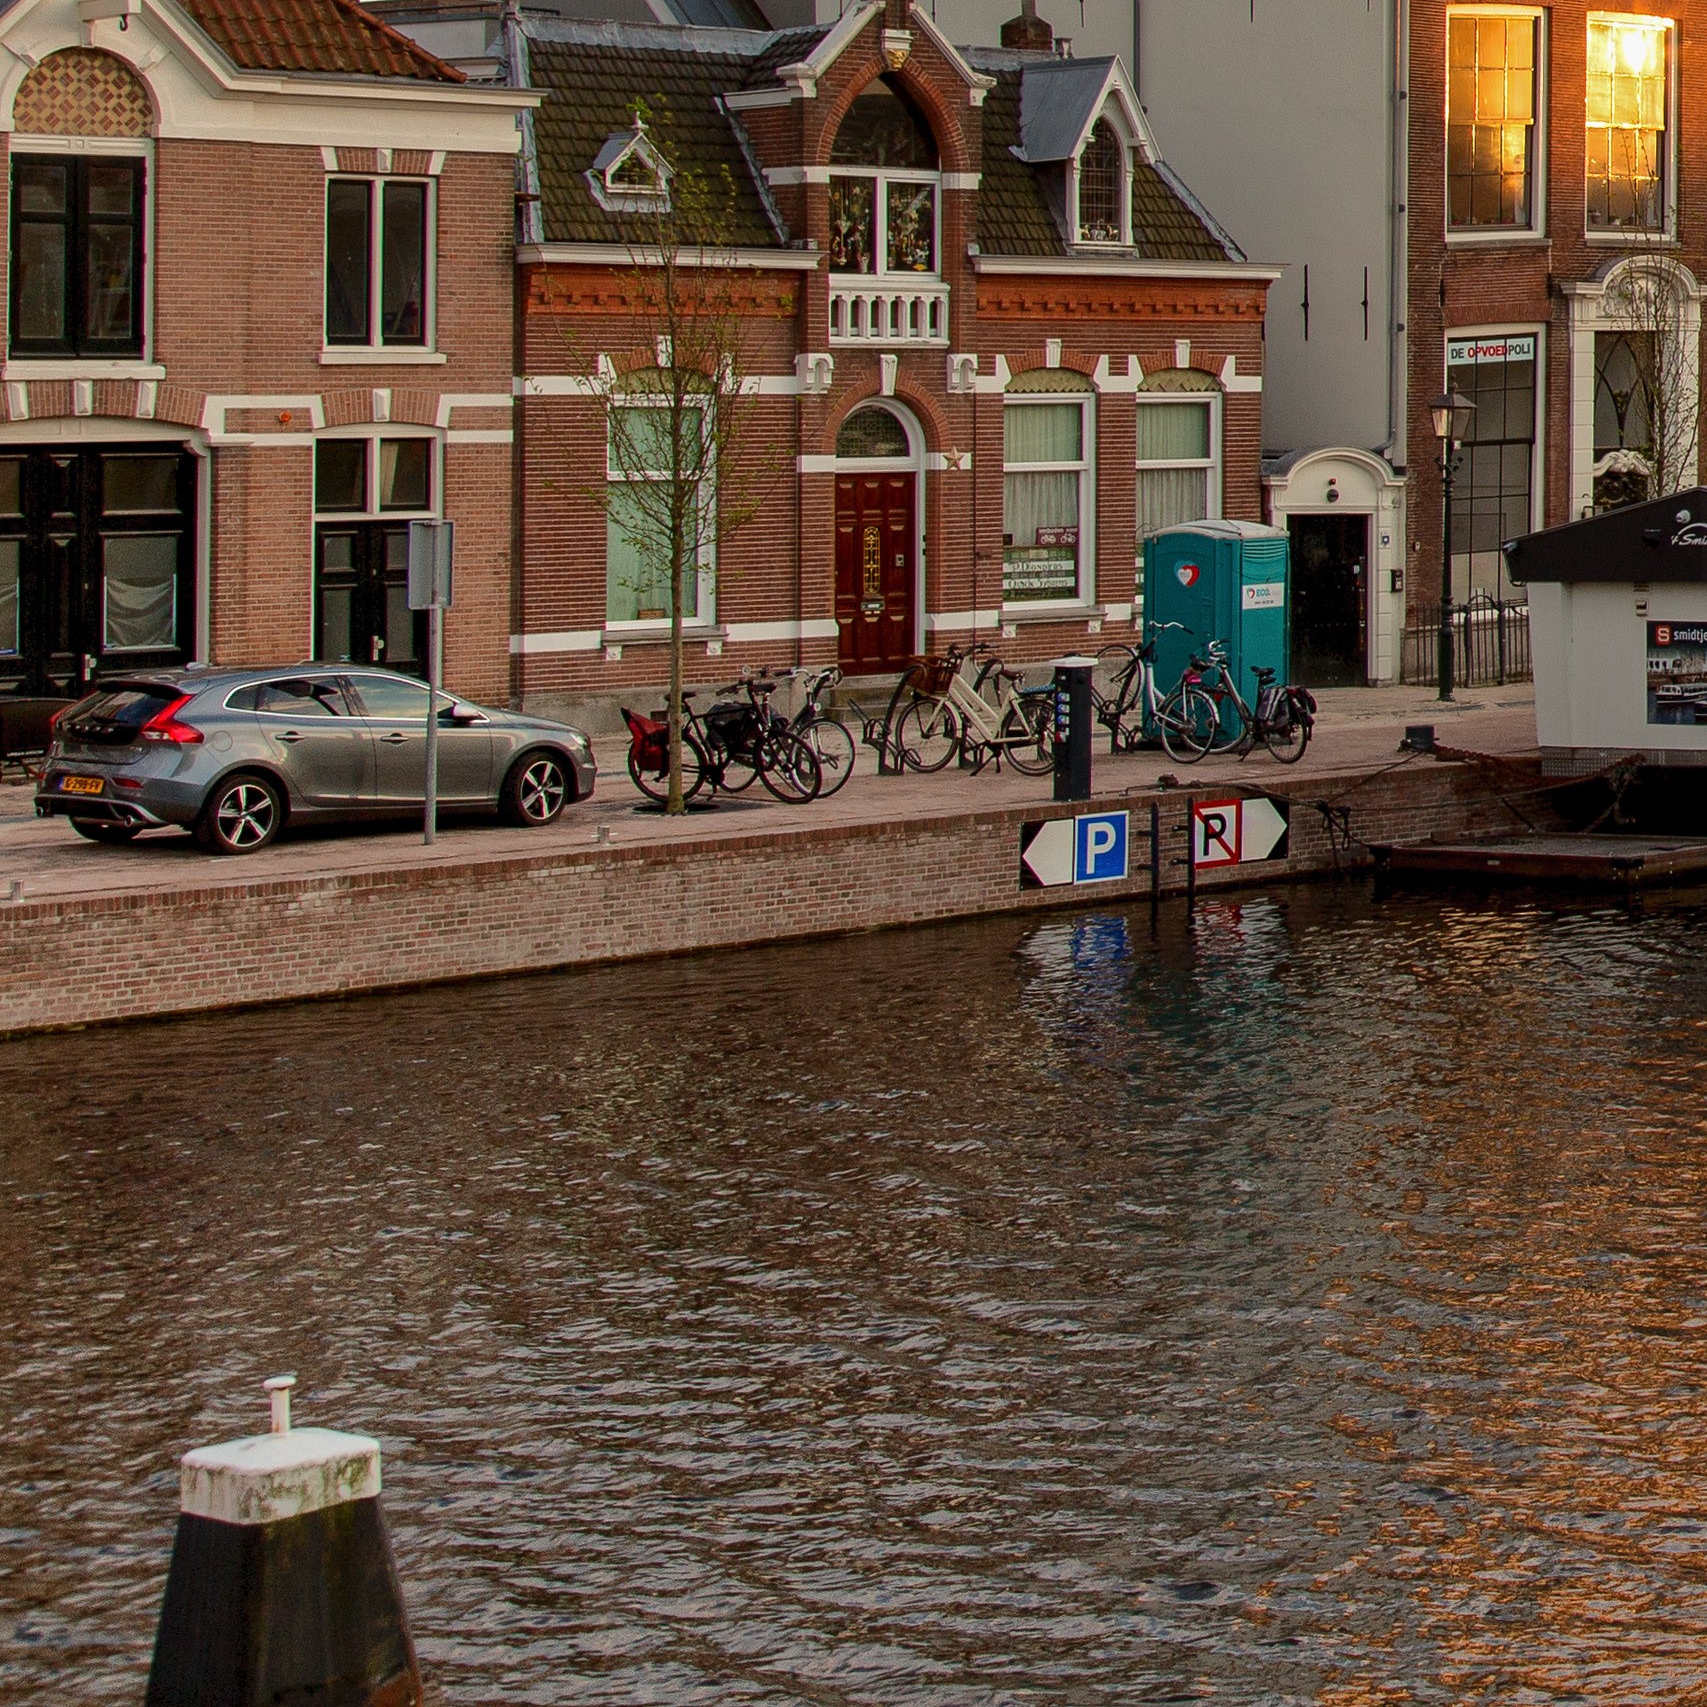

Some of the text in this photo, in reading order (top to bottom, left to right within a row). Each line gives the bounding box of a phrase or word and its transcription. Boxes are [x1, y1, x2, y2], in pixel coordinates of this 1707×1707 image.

[1451, 343, 1530, 359] DE OPVOEDPOLI
[1086, 821, 1117, 875] P
